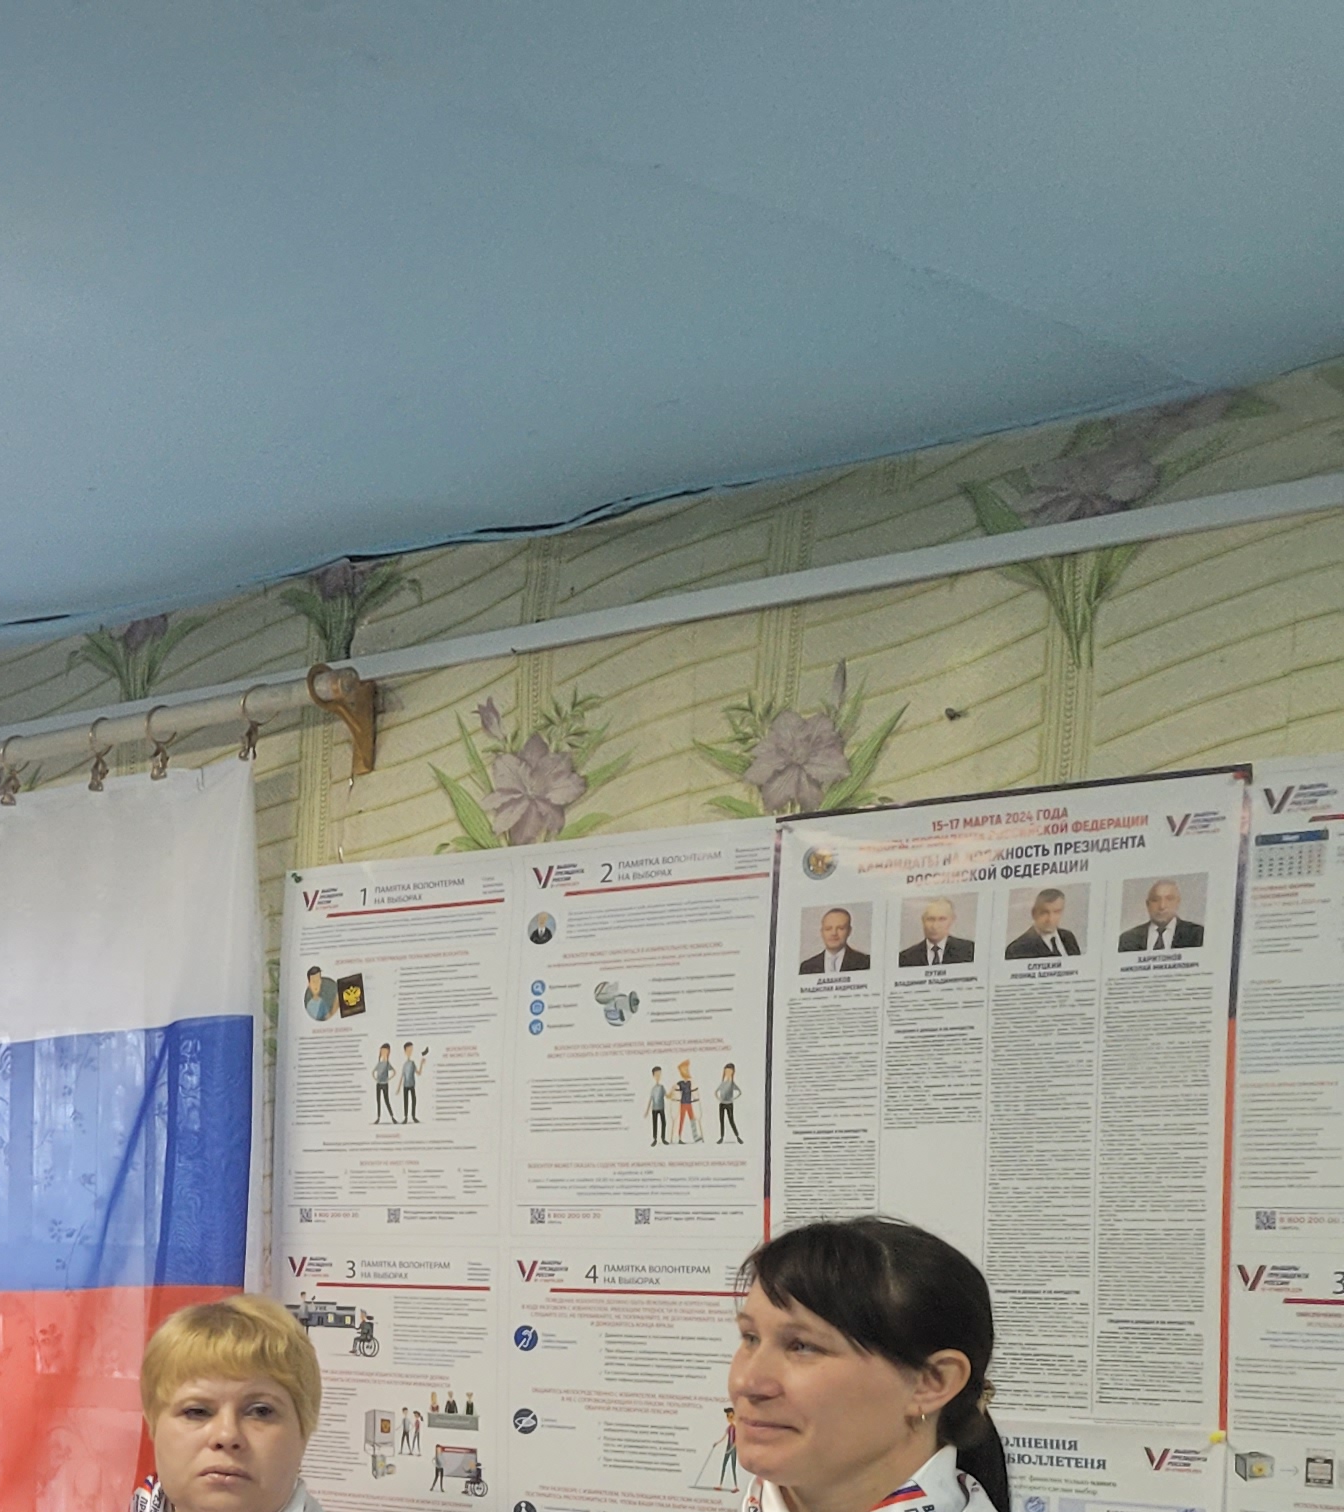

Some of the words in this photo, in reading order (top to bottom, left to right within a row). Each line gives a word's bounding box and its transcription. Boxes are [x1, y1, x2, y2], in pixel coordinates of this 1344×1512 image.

[963, 814, 1003, 828] МАРТА
[1005, 810, 1033, 825] 2024
[1036, 807, 1069, 822] ГОДА
[1072, 815, 1149, 833] ФЕДЕРАЦИИ
[1054, 835, 1146, 855] ПРЕЗИДЕНТА
[618, 857, 660, 870] ПАМЯТКА
[1001, 858, 1089, 880] ФЕДЕРАЦИИ
[600, 863, 612, 884] 2
[618, 872, 630, 882] НА
[632, 869, 673, 881] ВЫБОРАХ
[374, 885, 412, 895] ПАМЯТКА
[413, 878, 465, 891] ВОЛОНТЕРАМ
[360, 888, 367, 906] 1
[387, 894, 423, 905] ВЫБОРАХ
[346, 1260, 356, 1279] 3
[361, 1260, 397, 1269] ПАМЯТКА
[399, 1261, 450, 1270] ВОЛОНТЕРАМ
[584, 1264, 599, 1284] 4
[603, 1264, 647, 1274] ПАМЯТКА
[649, 1265, 711, 1275] ВОЛОНТЕРАМ
[603, 1276, 615, 1285] НА
[618, 1277, 661, 1286] ВЫБОРАХ
[1006, 1452, 1107, 1471] БЮЛЛЕТЕНЯ
